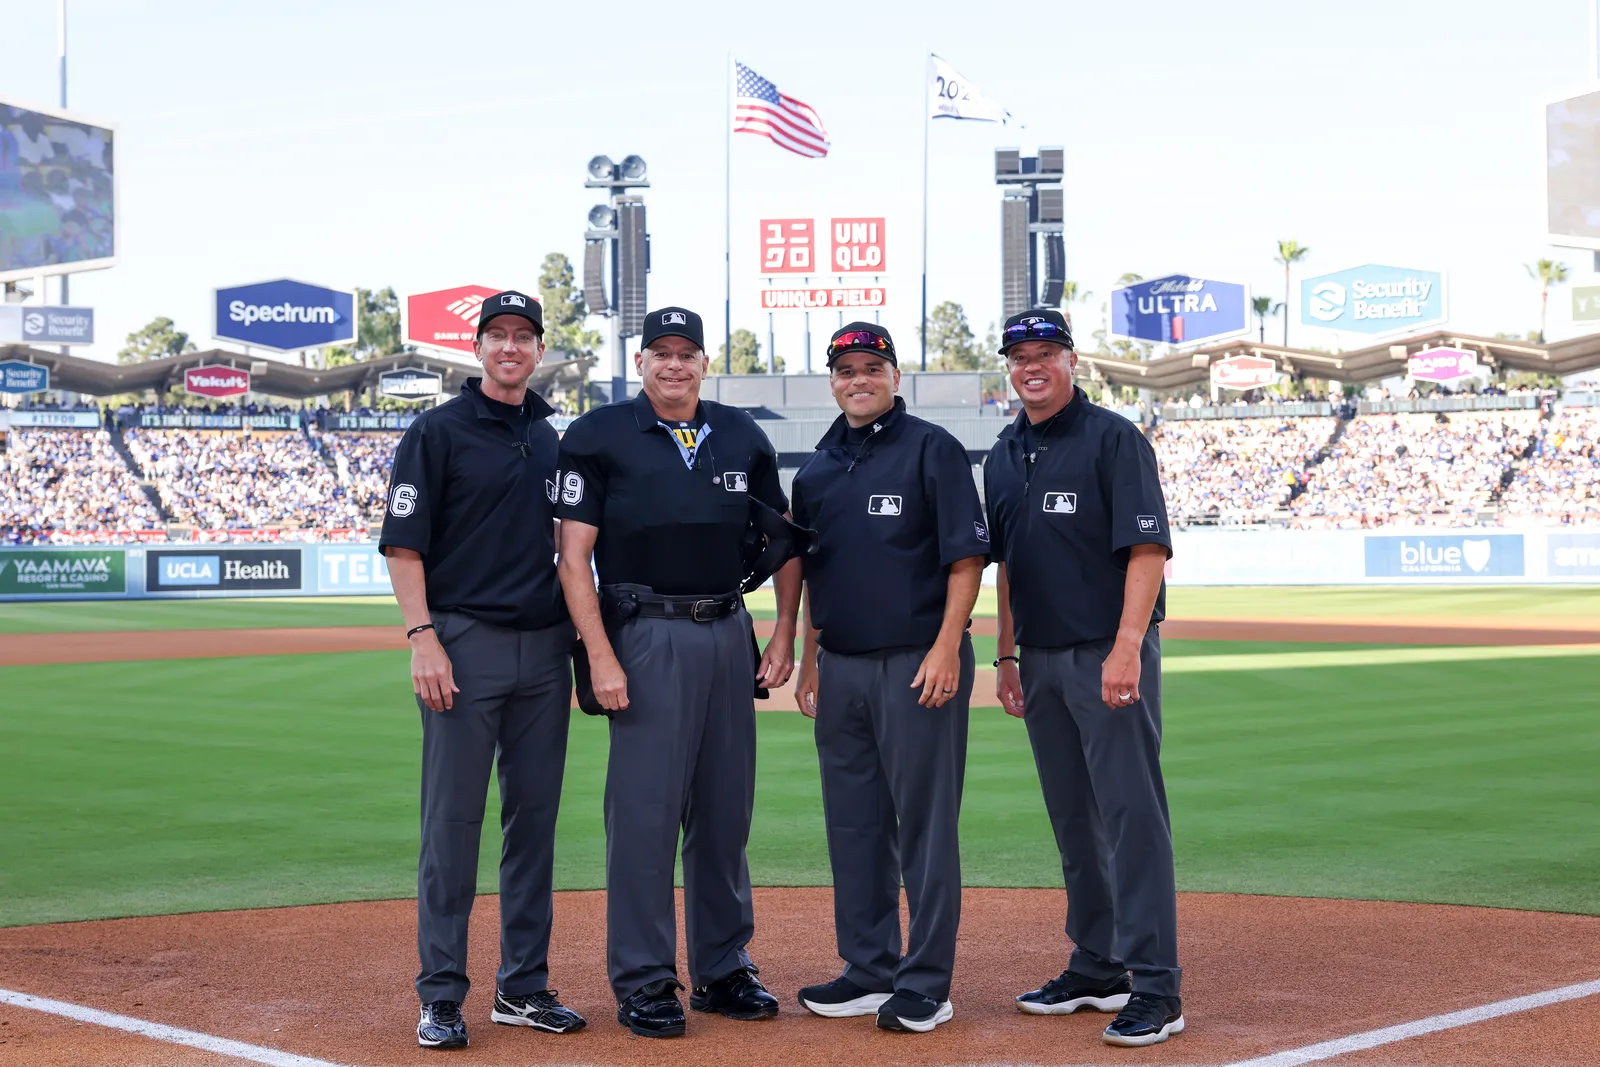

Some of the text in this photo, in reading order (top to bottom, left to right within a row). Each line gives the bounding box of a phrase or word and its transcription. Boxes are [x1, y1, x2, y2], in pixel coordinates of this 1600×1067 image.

[835, 222, 877, 244] UNI
[835, 245, 882, 270] QLO
[1352, 277, 1433, 301] Security
[765, 289, 883, 308] UNIQLO FIELD
[1138, 293, 1218, 315] ULTRA
[229, 300, 335, 327] Spectrum
[1353, 298, 1423, 320] Benefit
[47, 313, 90, 330] Security
[48, 325, 84, 336] Benefit
[434, 332, 473, 340] BANK OF
[5, 368, 42, 380] Security
[6, 378, 38, 388] Benefit
[189, 374, 247, 388] Yakult
[1140, 519, 1155, 529] BF
[1400, 541, 1462, 565] blue
[17, 573, 58, 583] RESORT
[69, 573, 109, 582] CASINO
[166, 560, 290, 580] UCLA Health
[1400, 565, 1462, 573] CALIFORNIA
